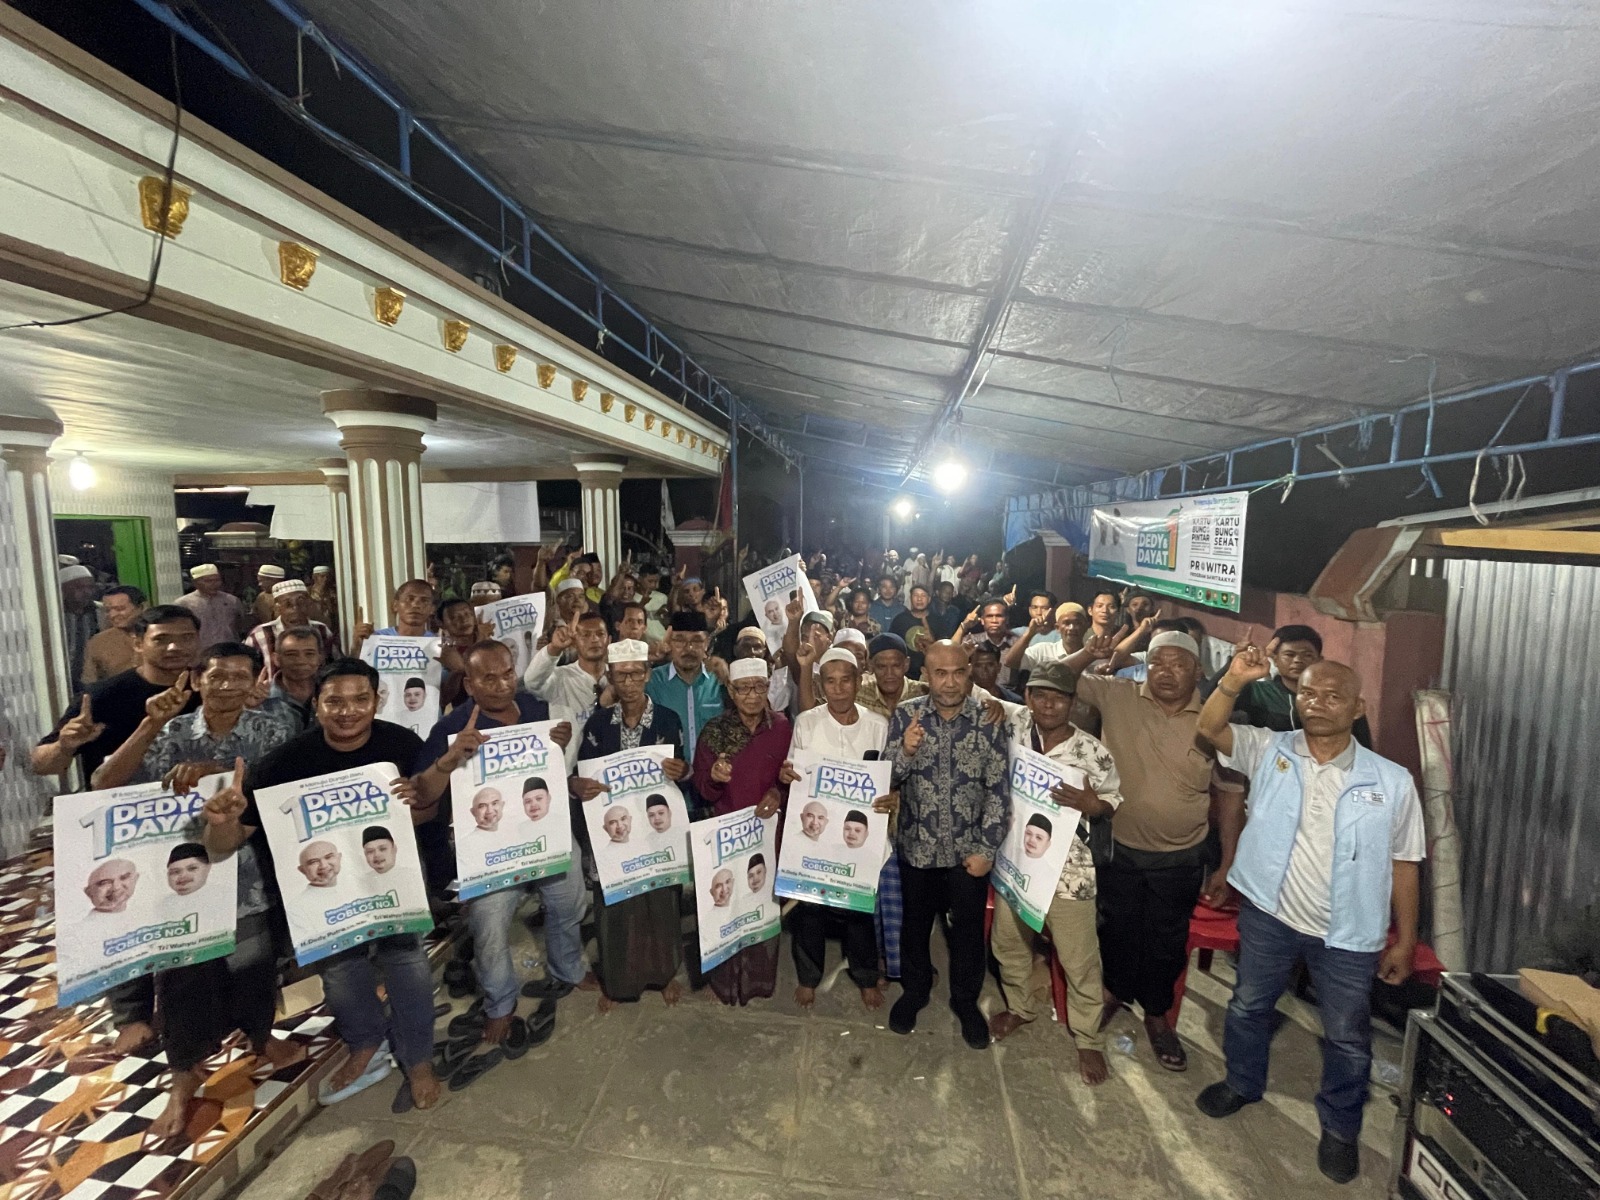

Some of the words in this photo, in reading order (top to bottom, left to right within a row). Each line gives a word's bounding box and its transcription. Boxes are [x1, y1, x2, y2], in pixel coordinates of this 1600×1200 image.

[1215, 517, 1240, 526] KARTU
[1138, 533, 1164, 548] DEDY
[1192, 533, 1210, 542] PINTAR
[1214, 537, 1239, 547] SEHAT
[1137, 549, 1169, 566] DAYAT
[761, 567, 789, 585] DEDY
[764, 573, 797, 594] DAYAT
[498, 604, 531, 621] DEDY
[501, 613, 537, 630] DAYAT
[378, 646, 419, 658] DEDY
[378, 658, 427, 669] DAYAT
[483, 735, 535, 759] DEDY
[484, 750, 545, 775] DAYAT
[607, 759, 652, 782] DEDY
[1015, 758, 1062, 788] DEDY
[611, 771, 664, 796] DAYAT
[820, 766, 868, 787] DEDY
[303, 782, 371, 812] DEDY
[820, 779, 876, 803] DAYAT
[1012, 774, 1061, 809] DAYA
[113, 793, 197, 825] DEDY
[308, 795, 387, 828] DAYAT
[720, 817, 756, 843] DEDY
[721, 828, 763, 858] DAYAT
[486, 848, 523, 866] COBLOS
[623, 857, 657, 873] COBLOS
[802, 862, 833, 873] COBLOS
[327, 902, 375, 924] COBLOS
[104, 928, 162, 957] COBLOS
